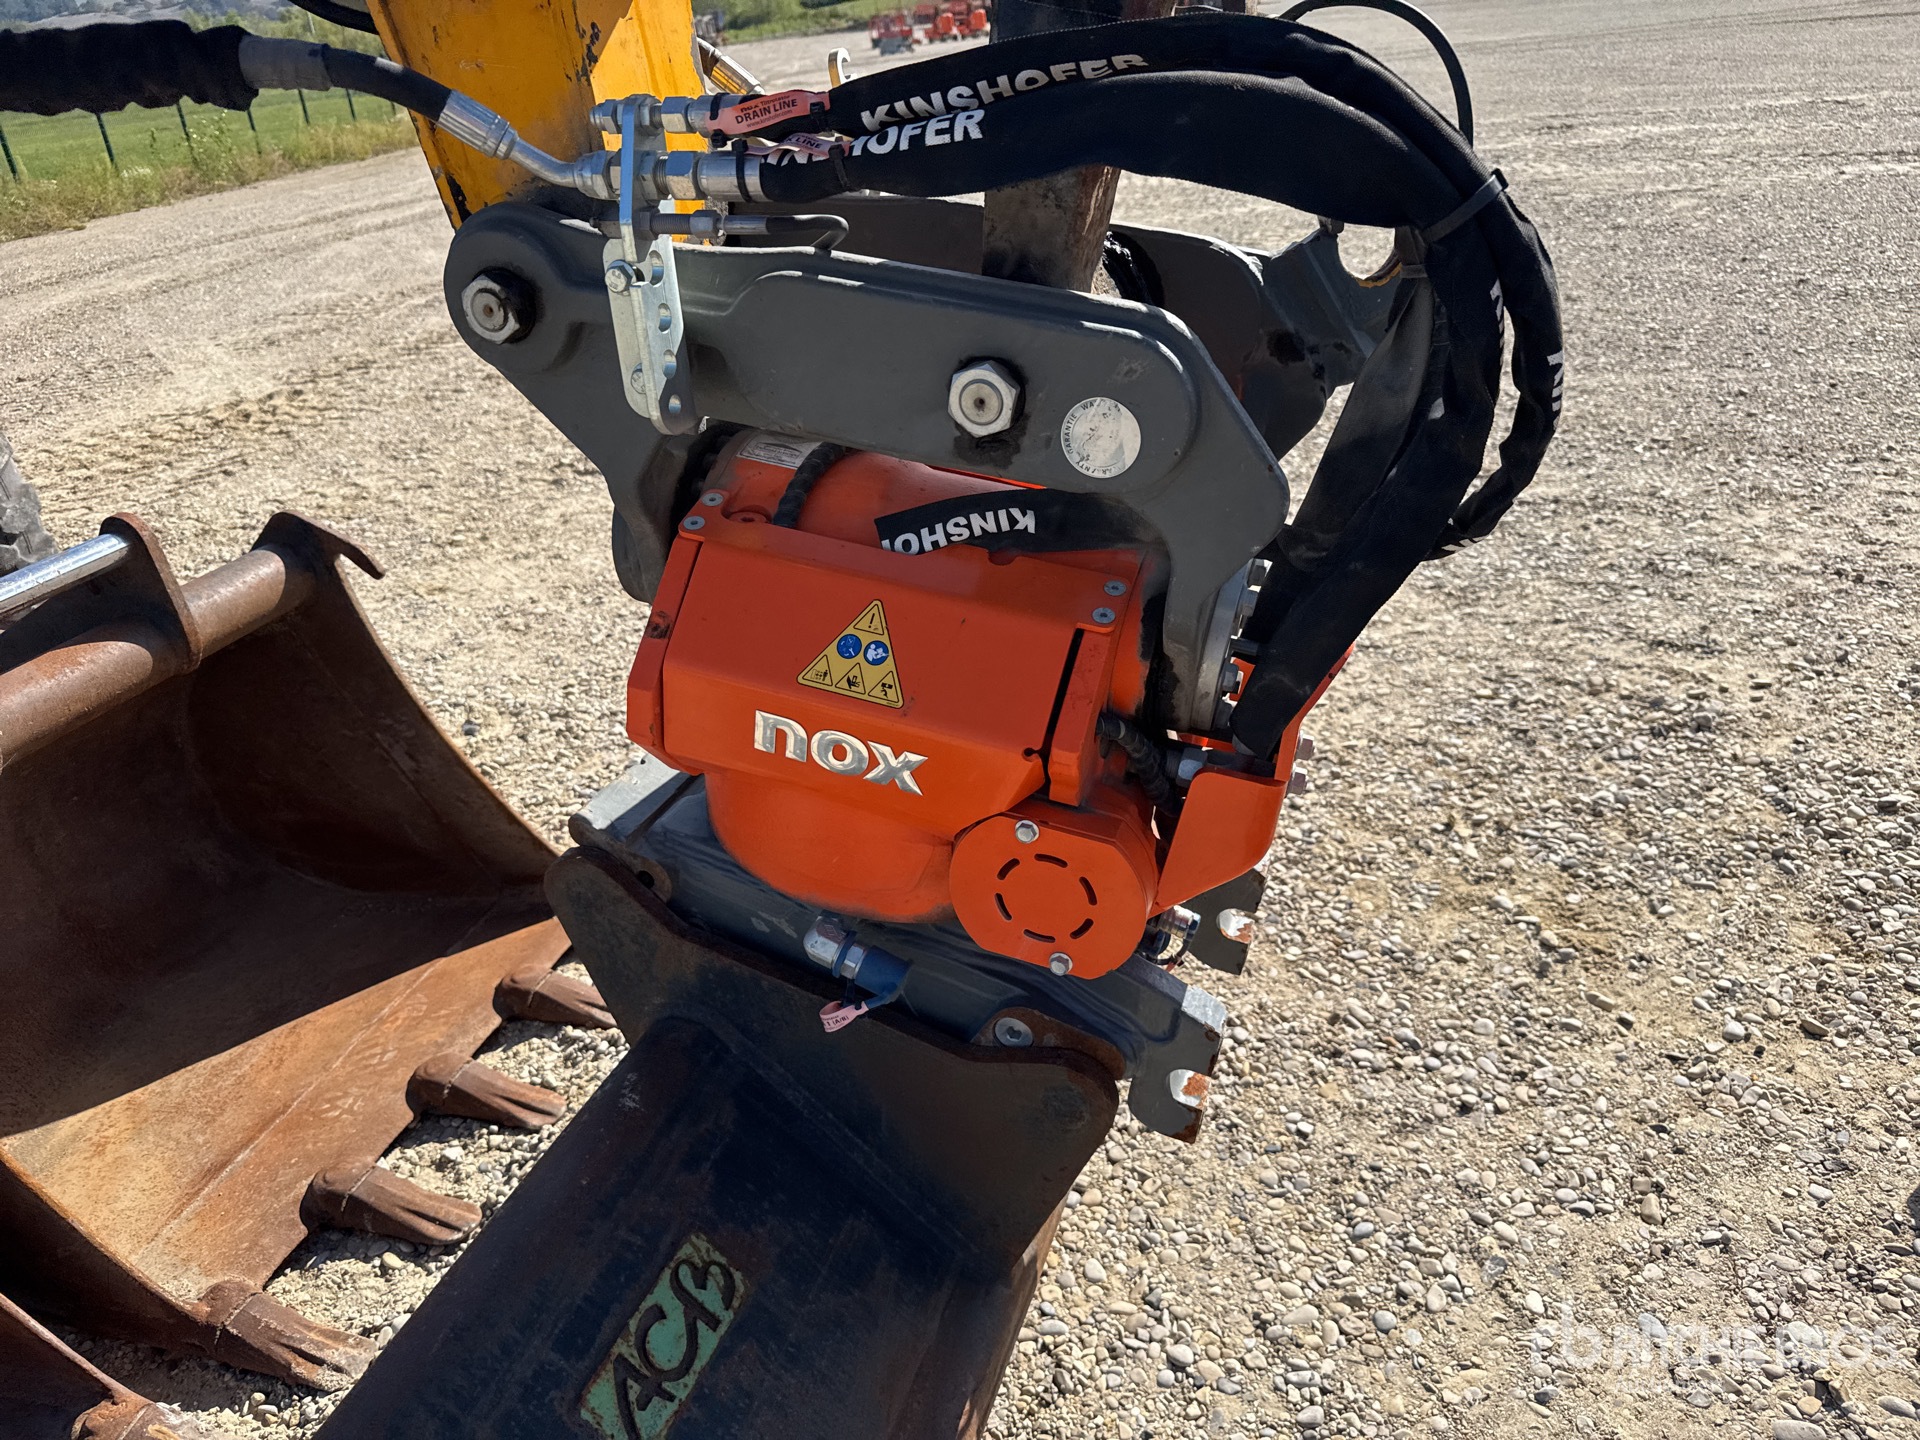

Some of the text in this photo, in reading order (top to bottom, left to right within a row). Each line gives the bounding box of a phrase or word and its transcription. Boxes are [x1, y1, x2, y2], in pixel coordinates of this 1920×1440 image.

[735, 98, 798, 125] DRAIN LINE
[860, 54, 1149, 132] KINSHOFER
[1064, 413, 1078, 455] GARANTIE
[754, 709, 929, 796] nox
